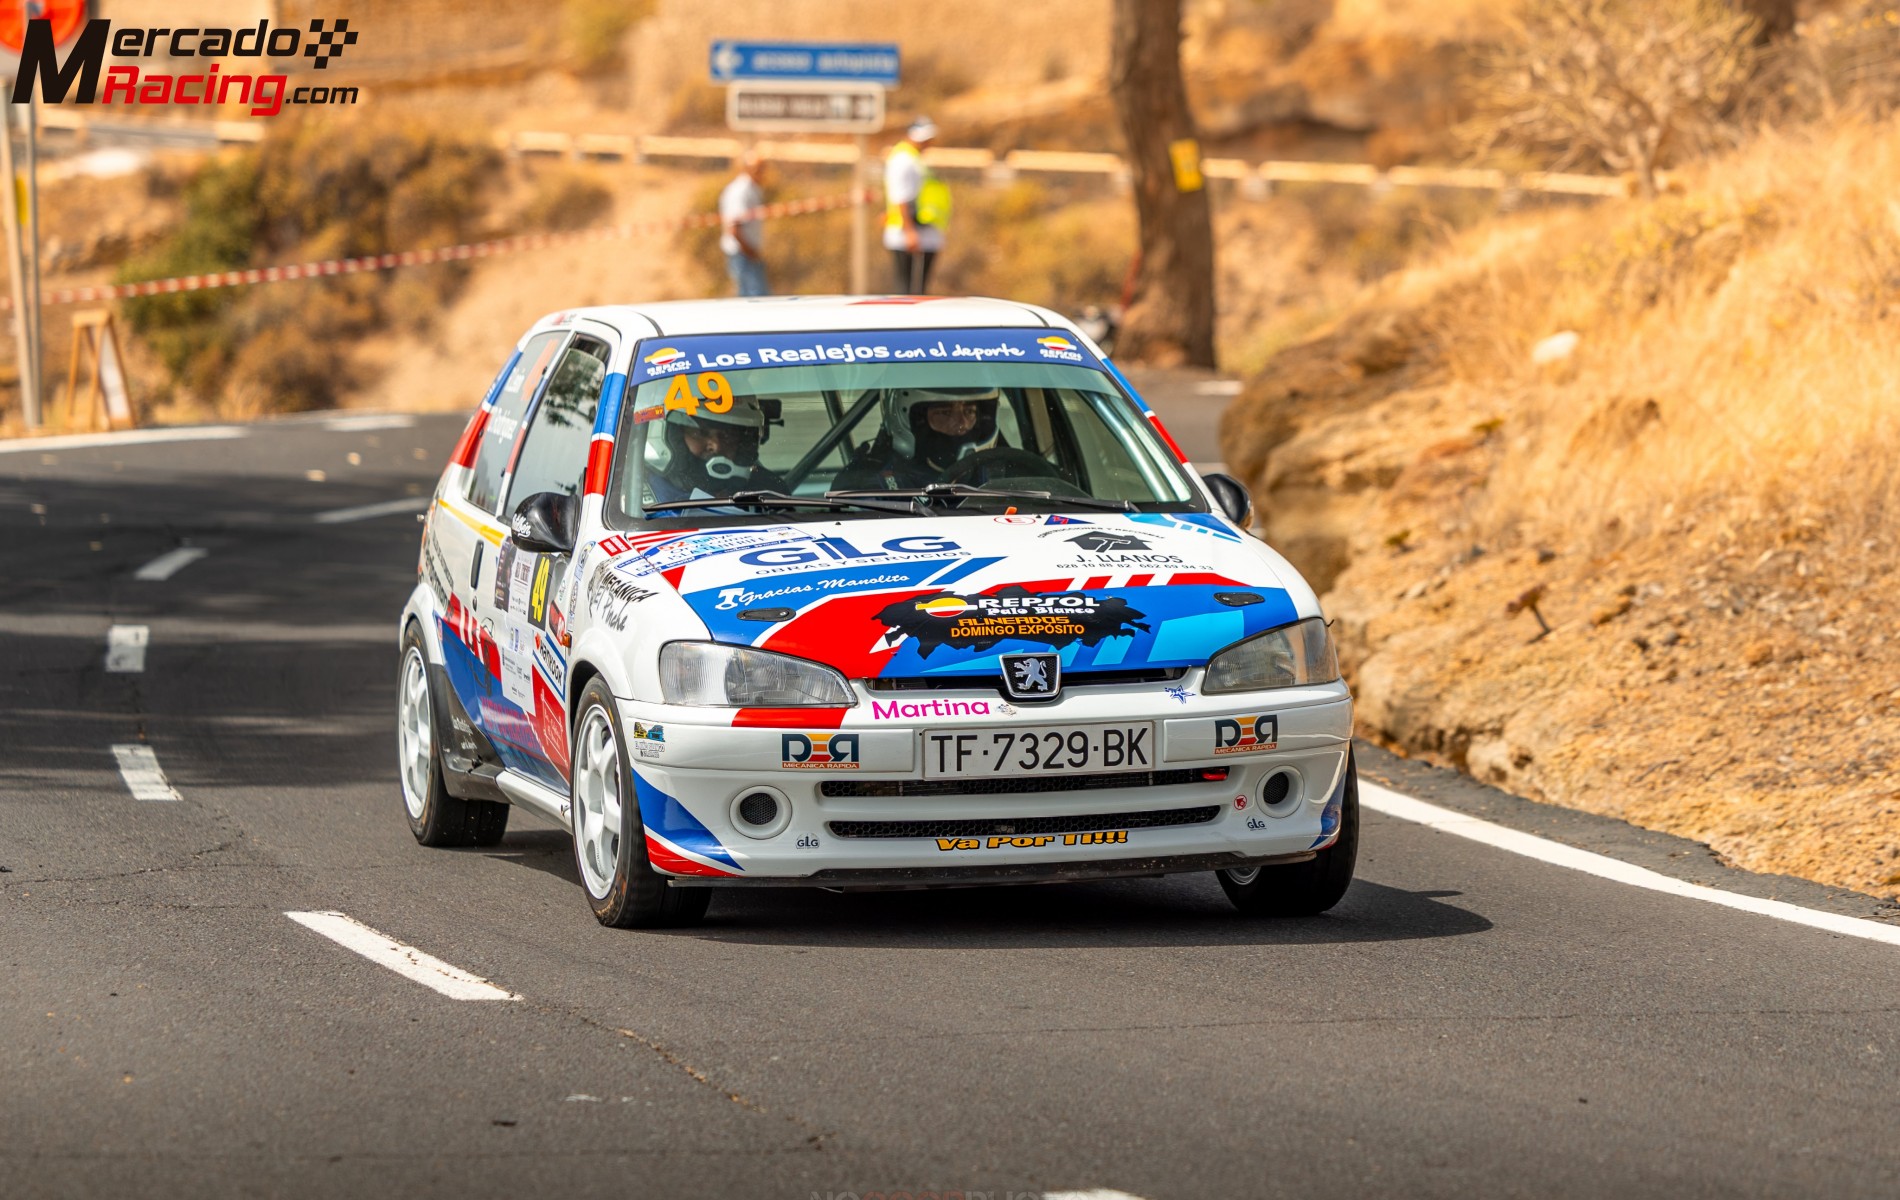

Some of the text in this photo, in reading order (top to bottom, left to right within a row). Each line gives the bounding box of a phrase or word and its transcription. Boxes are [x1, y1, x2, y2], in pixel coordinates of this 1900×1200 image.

[697, 352, 751, 368] Los
[757, 343, 889, 363] Realejos
[894, 347, 926, 359] con
[929, 341, 947, 358] el
[951, 342, 1026, 361] deporte
[663, 371, 734, 417] 49
[755, 561, 823, 575] OBRAS
[855, 551, 971, 564] SERVICIOS
[1076, 554, 1183, 563] J. LLANOS
[531, 556, 550, 623] 49
[978, 596, 1100, 609] REPSOL
[985, 606, 1096, 616] Palo Blanco
[957, 616, 1070, 626] ALINEADOS
[951, 624, 1015, 638] DOMINGO
[872, 698, 990, 720] Martina
[935, 838, 980, 851] Va
[986, 836, 1055, 849] Por
